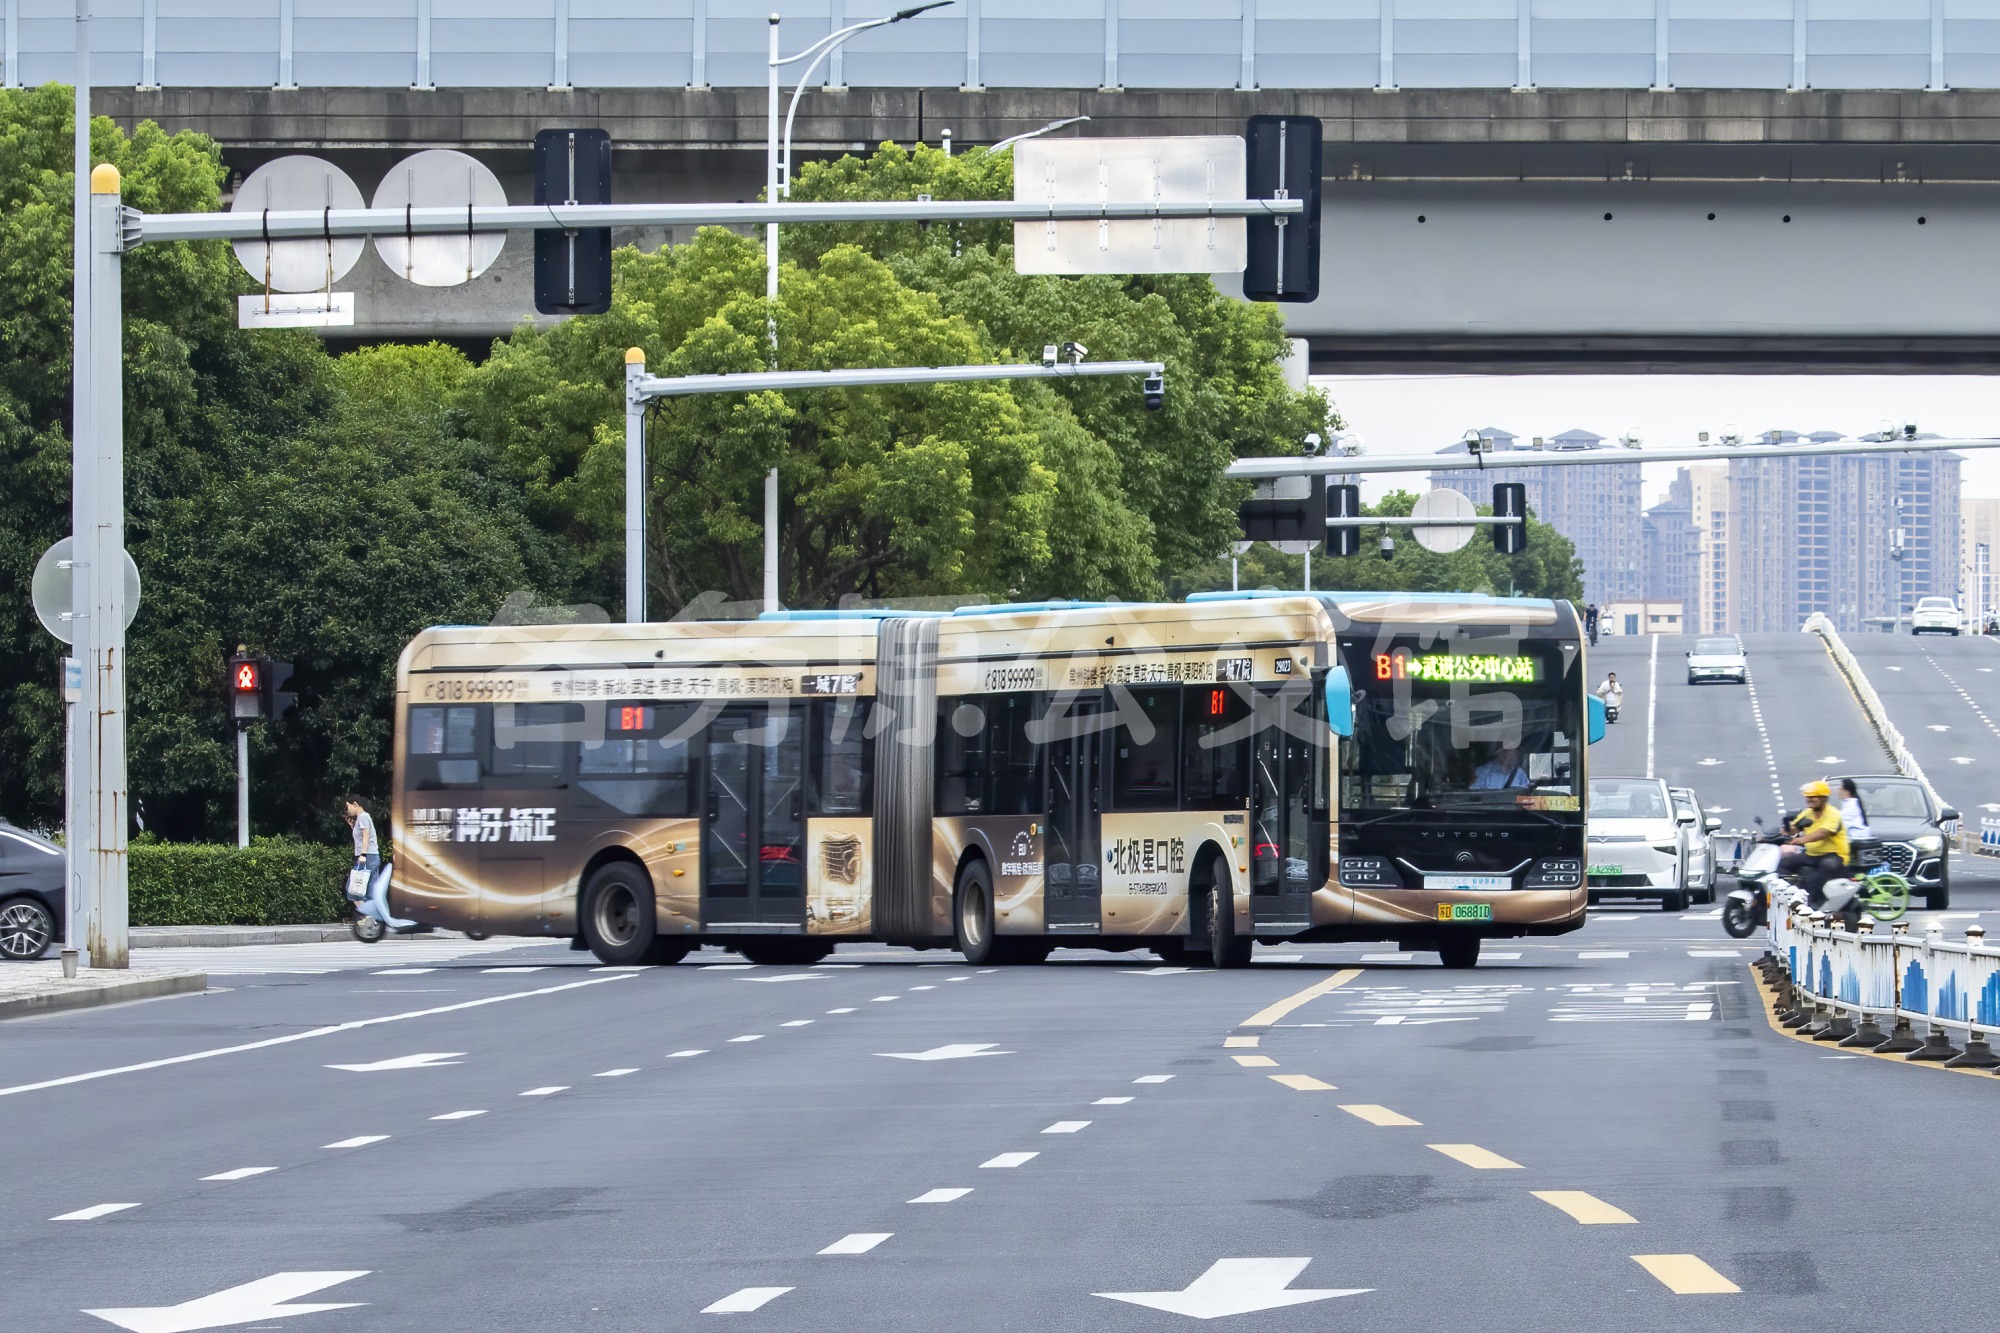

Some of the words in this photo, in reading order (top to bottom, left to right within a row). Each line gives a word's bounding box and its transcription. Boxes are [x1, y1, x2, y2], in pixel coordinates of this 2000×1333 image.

[1376, 654, 1406, 680] B1
[1421, 655, 1535, 682] 武进公交中心站
[1211, 690, 1224, 714] B1
[621, 706, 643, 730] B1
[1113, 837, 1185, 875] 北极星口腔
